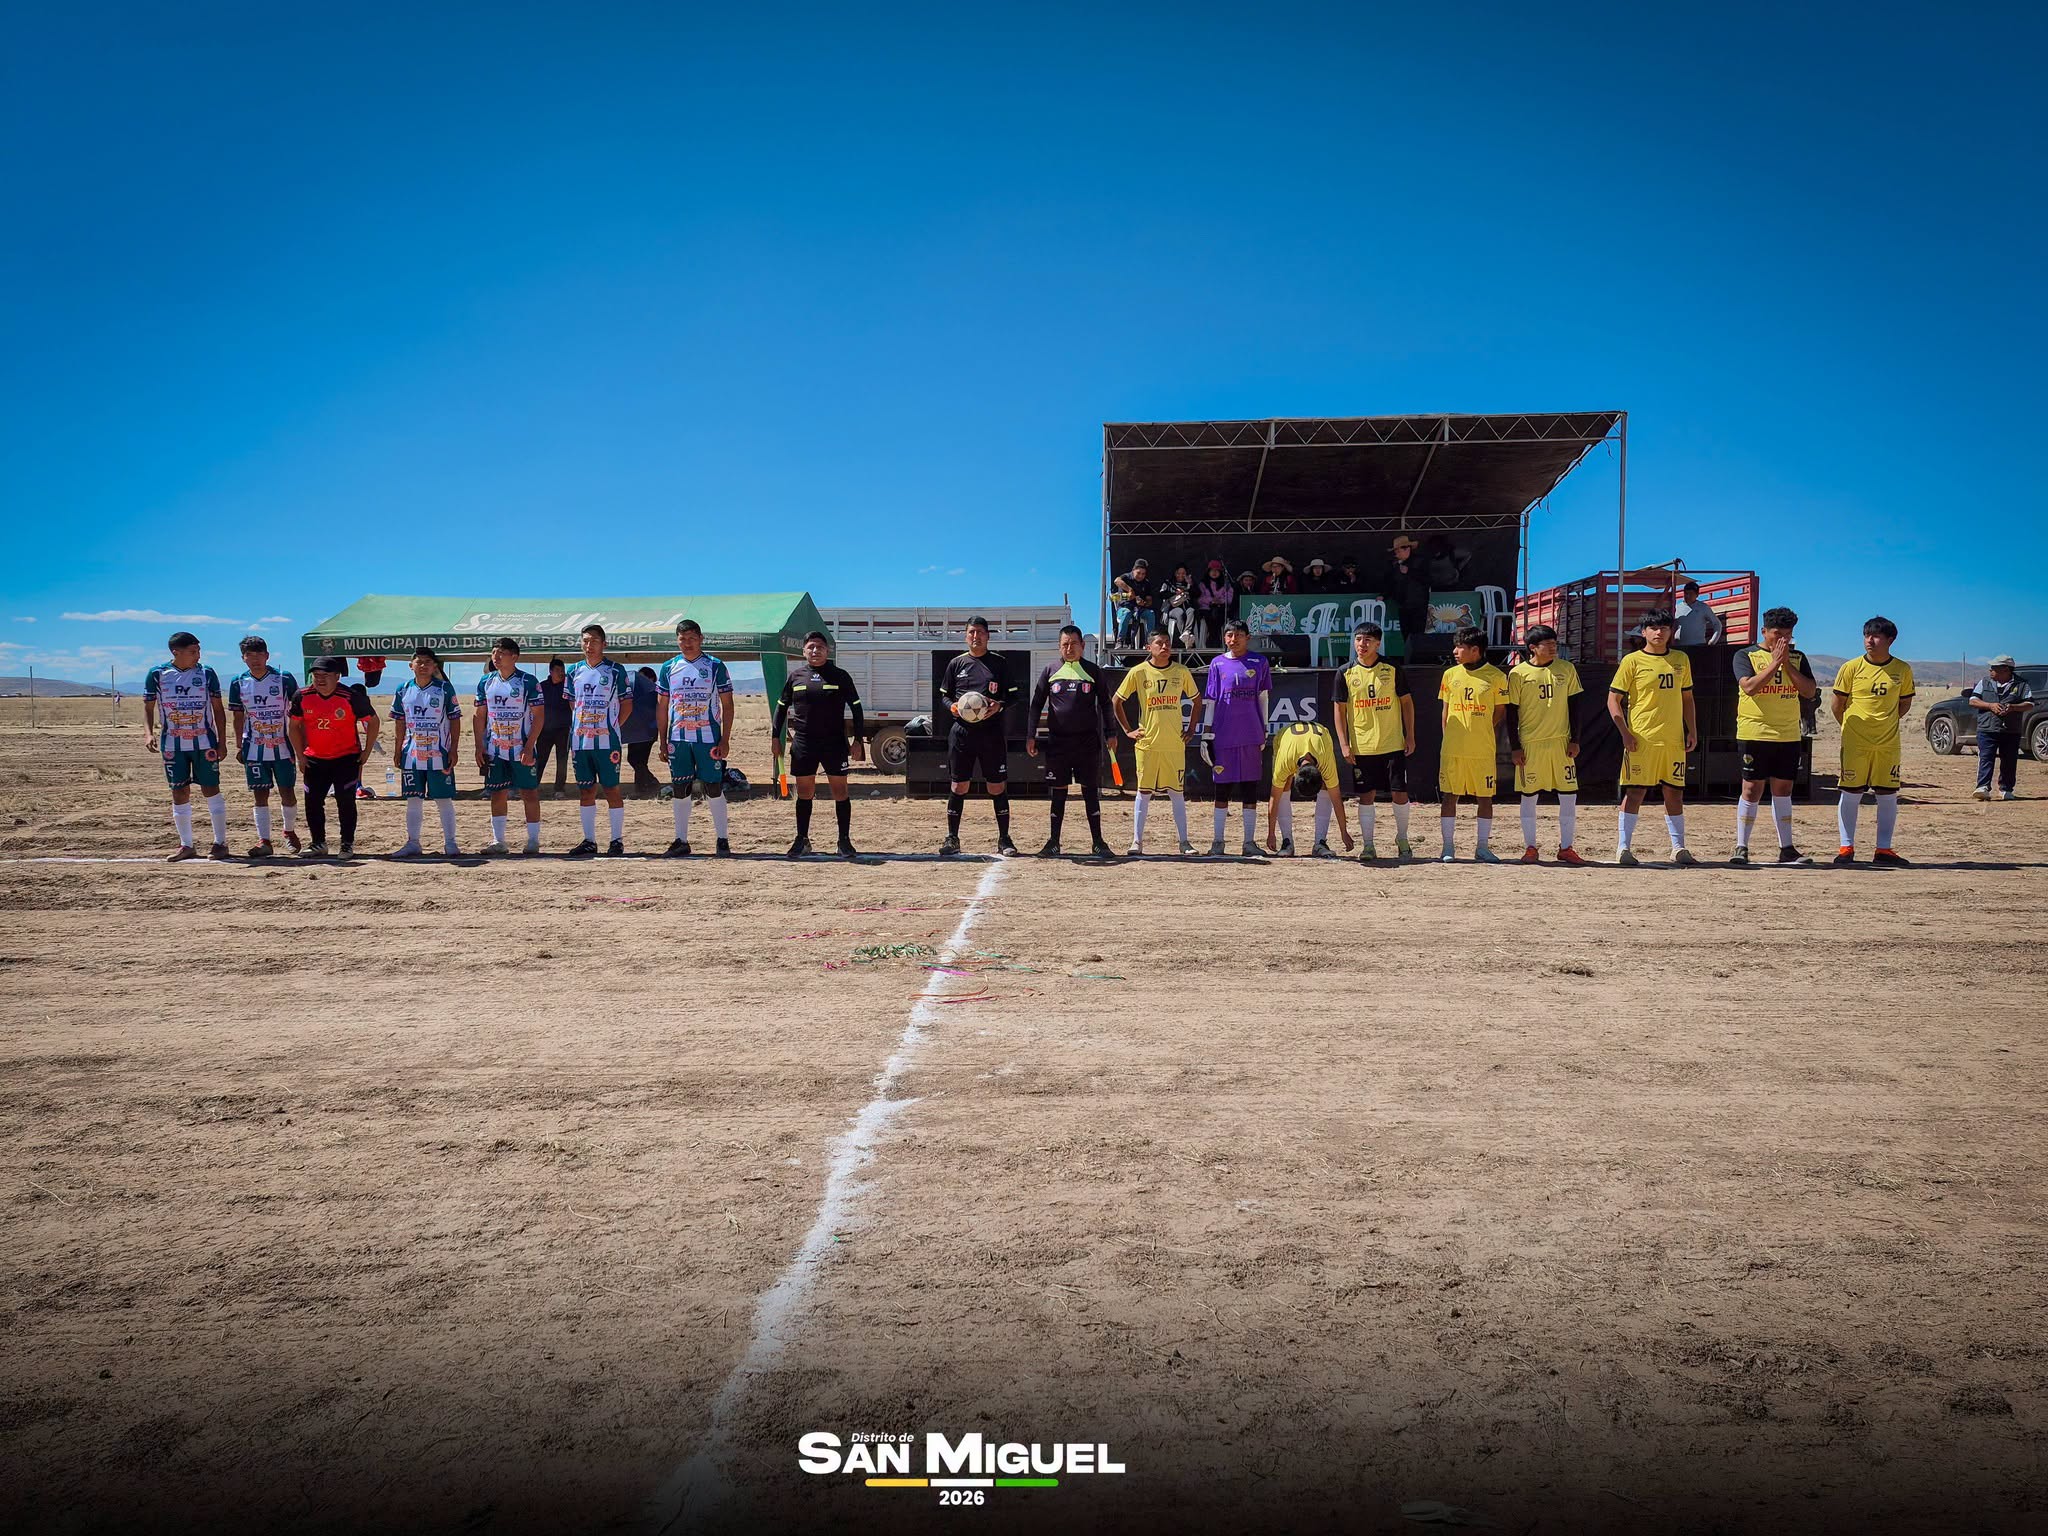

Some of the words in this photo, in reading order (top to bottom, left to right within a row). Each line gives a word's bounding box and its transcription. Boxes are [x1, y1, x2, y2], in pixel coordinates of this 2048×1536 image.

[454, 613, 526, 632] San
[343, 635, 459, 651] MUNICIPALIDAD
[463, 636, 537, 649] DISTTAL
[541, 636, 561, 647] DE
[1658, 673, 1674, 689] 20
[1774, 670, 1783, 685] 9
[1157, 679, 1168, 693] 17
[1368, 684, 1376, 699] 8
[1538, 683, 1554, 700] 30
[1871, 682, 1888, 696] 45
[1464, 687, 1474, 701] 12
[317, 718, 330, 730] 22
[166, 765, 174, 777] 5
[252, 766, 261, 779] 9
[1564, 765, 1576, 781] 30
[1672, 761, 1685, 777] 20
[403, 773, 415, 787] 12
